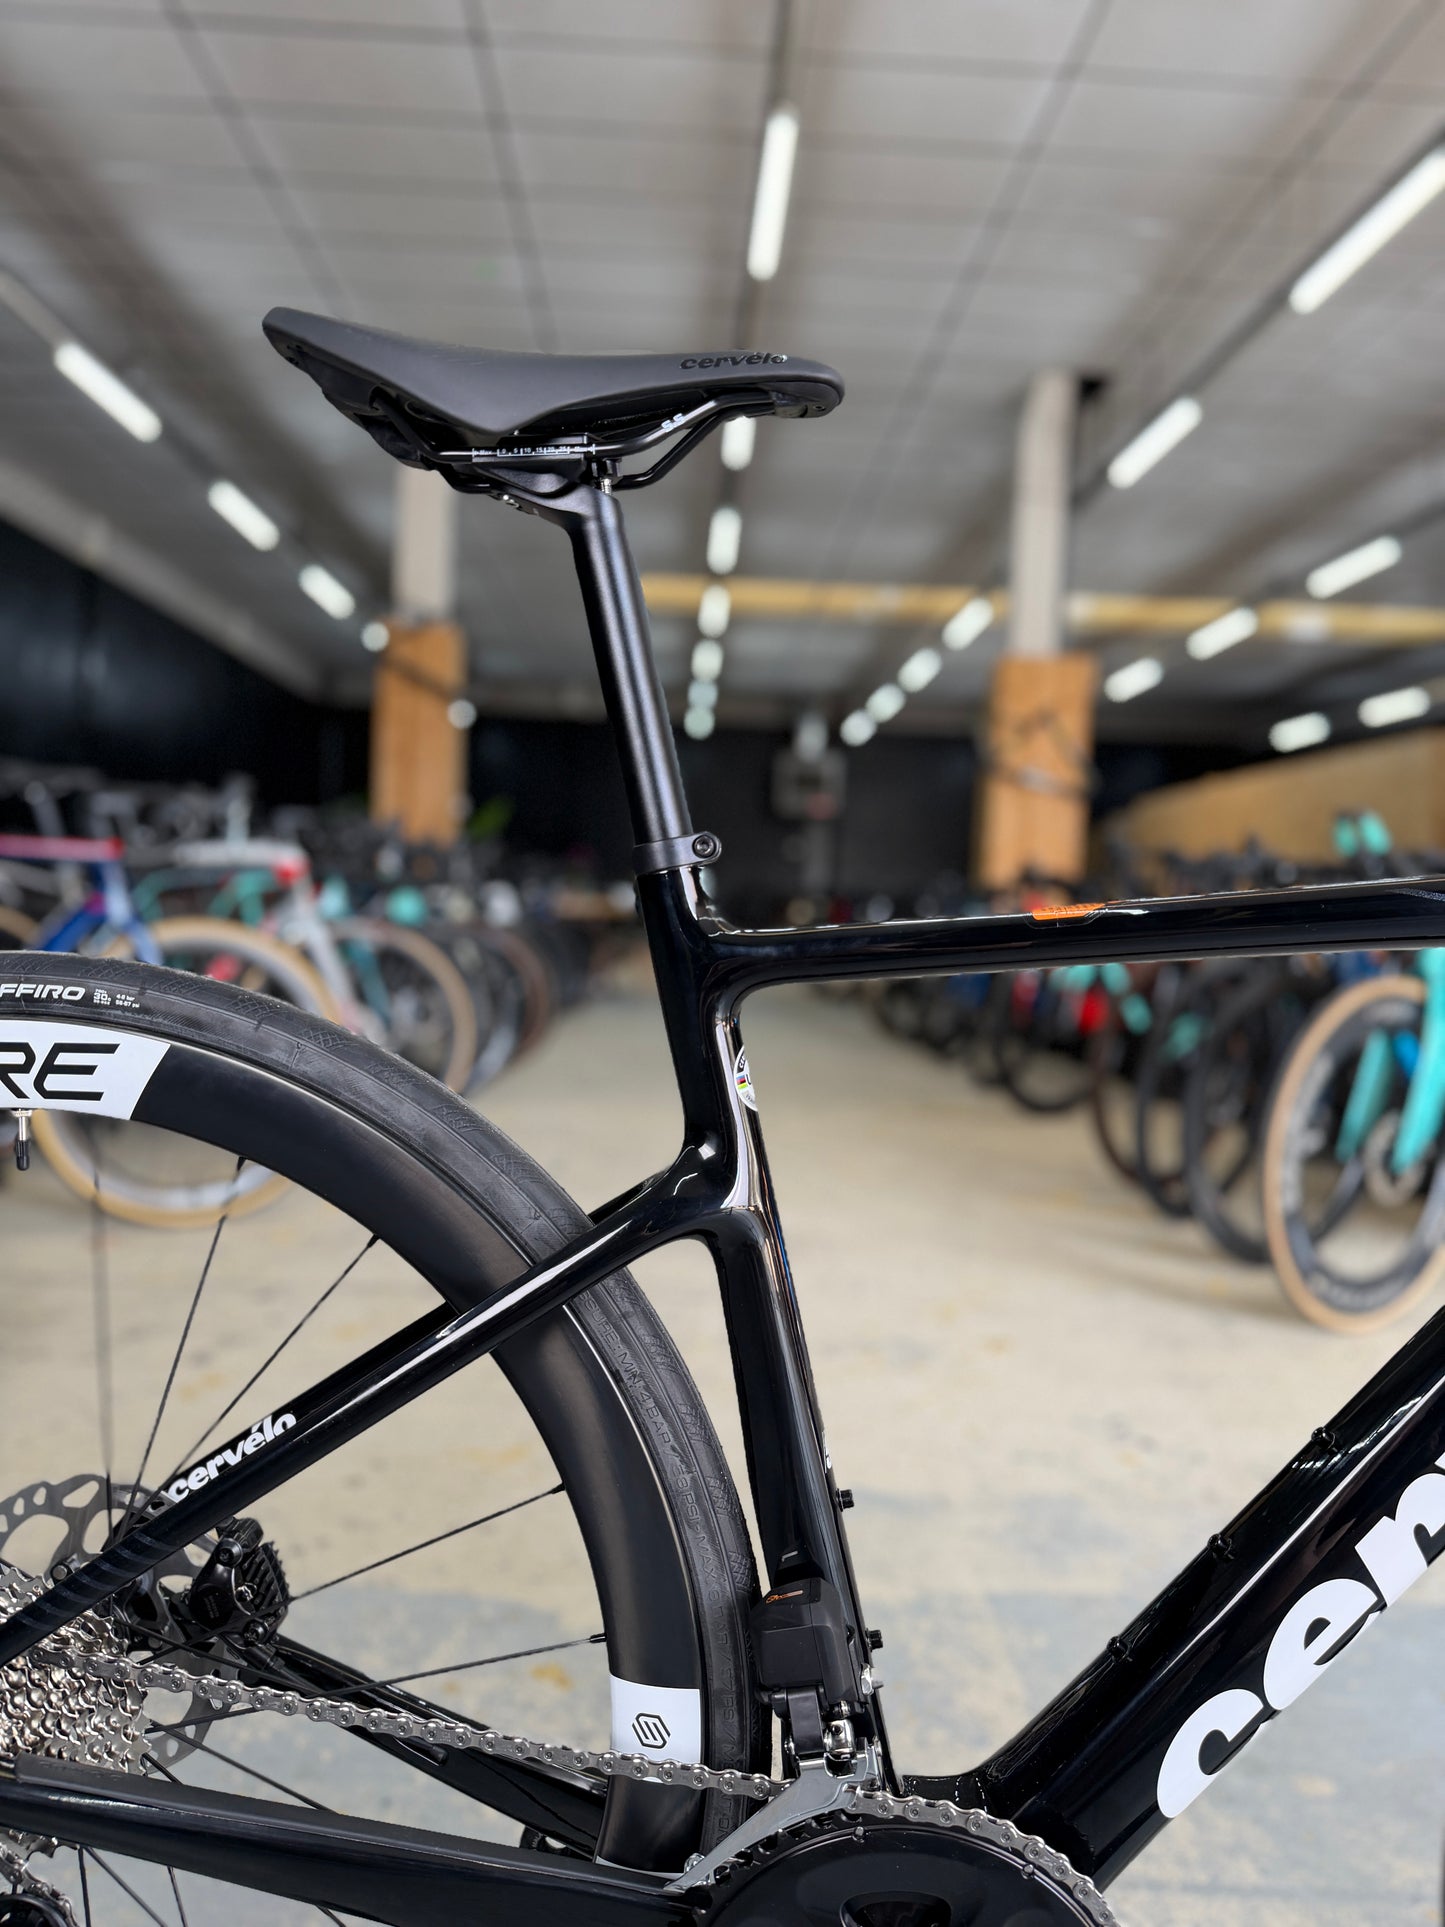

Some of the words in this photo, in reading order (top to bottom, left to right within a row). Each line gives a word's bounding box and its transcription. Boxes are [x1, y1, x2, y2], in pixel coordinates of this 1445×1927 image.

[0, 1041, 120, 1101] RE
[167, 1413, 297, 1503] cervélo
[1157, 1452, 1445, 1818] cer
